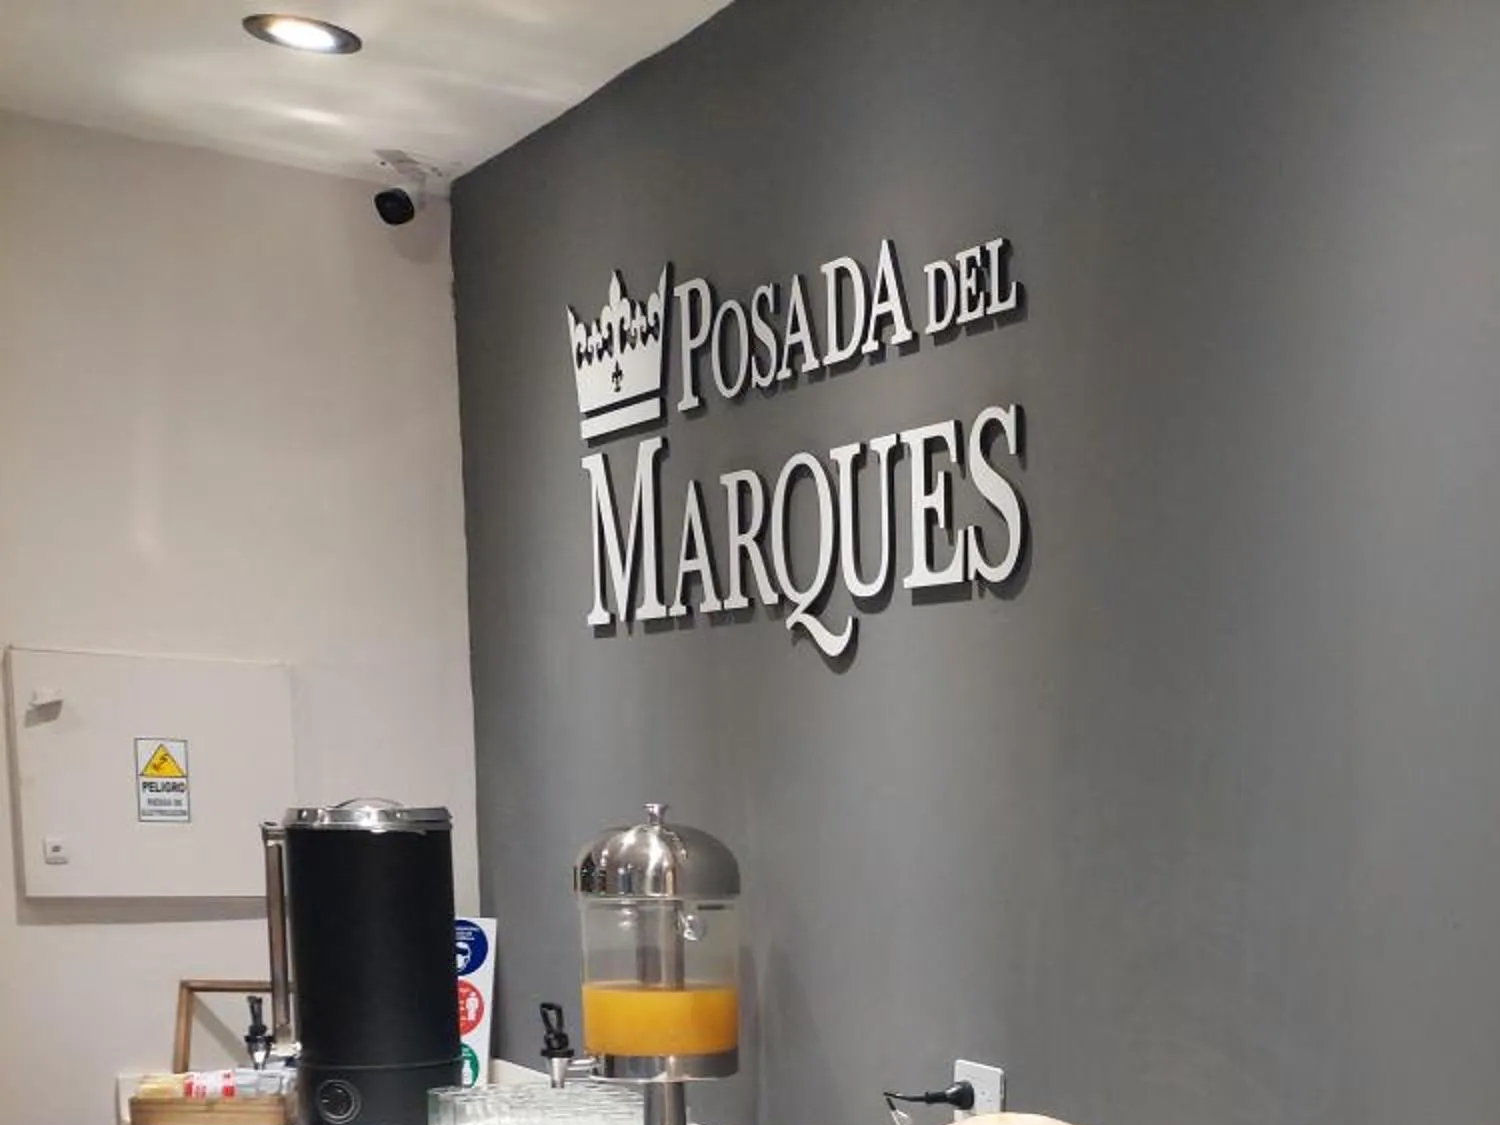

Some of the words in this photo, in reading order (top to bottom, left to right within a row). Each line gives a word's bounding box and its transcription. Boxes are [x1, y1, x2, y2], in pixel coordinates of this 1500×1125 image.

[674, 239, 913, 412] POSADA
[924, 238, 1018, 335] DEL
[581, 404, 1022, 657] MARQUES
[142, 781, 187, 793] PELIGRO
